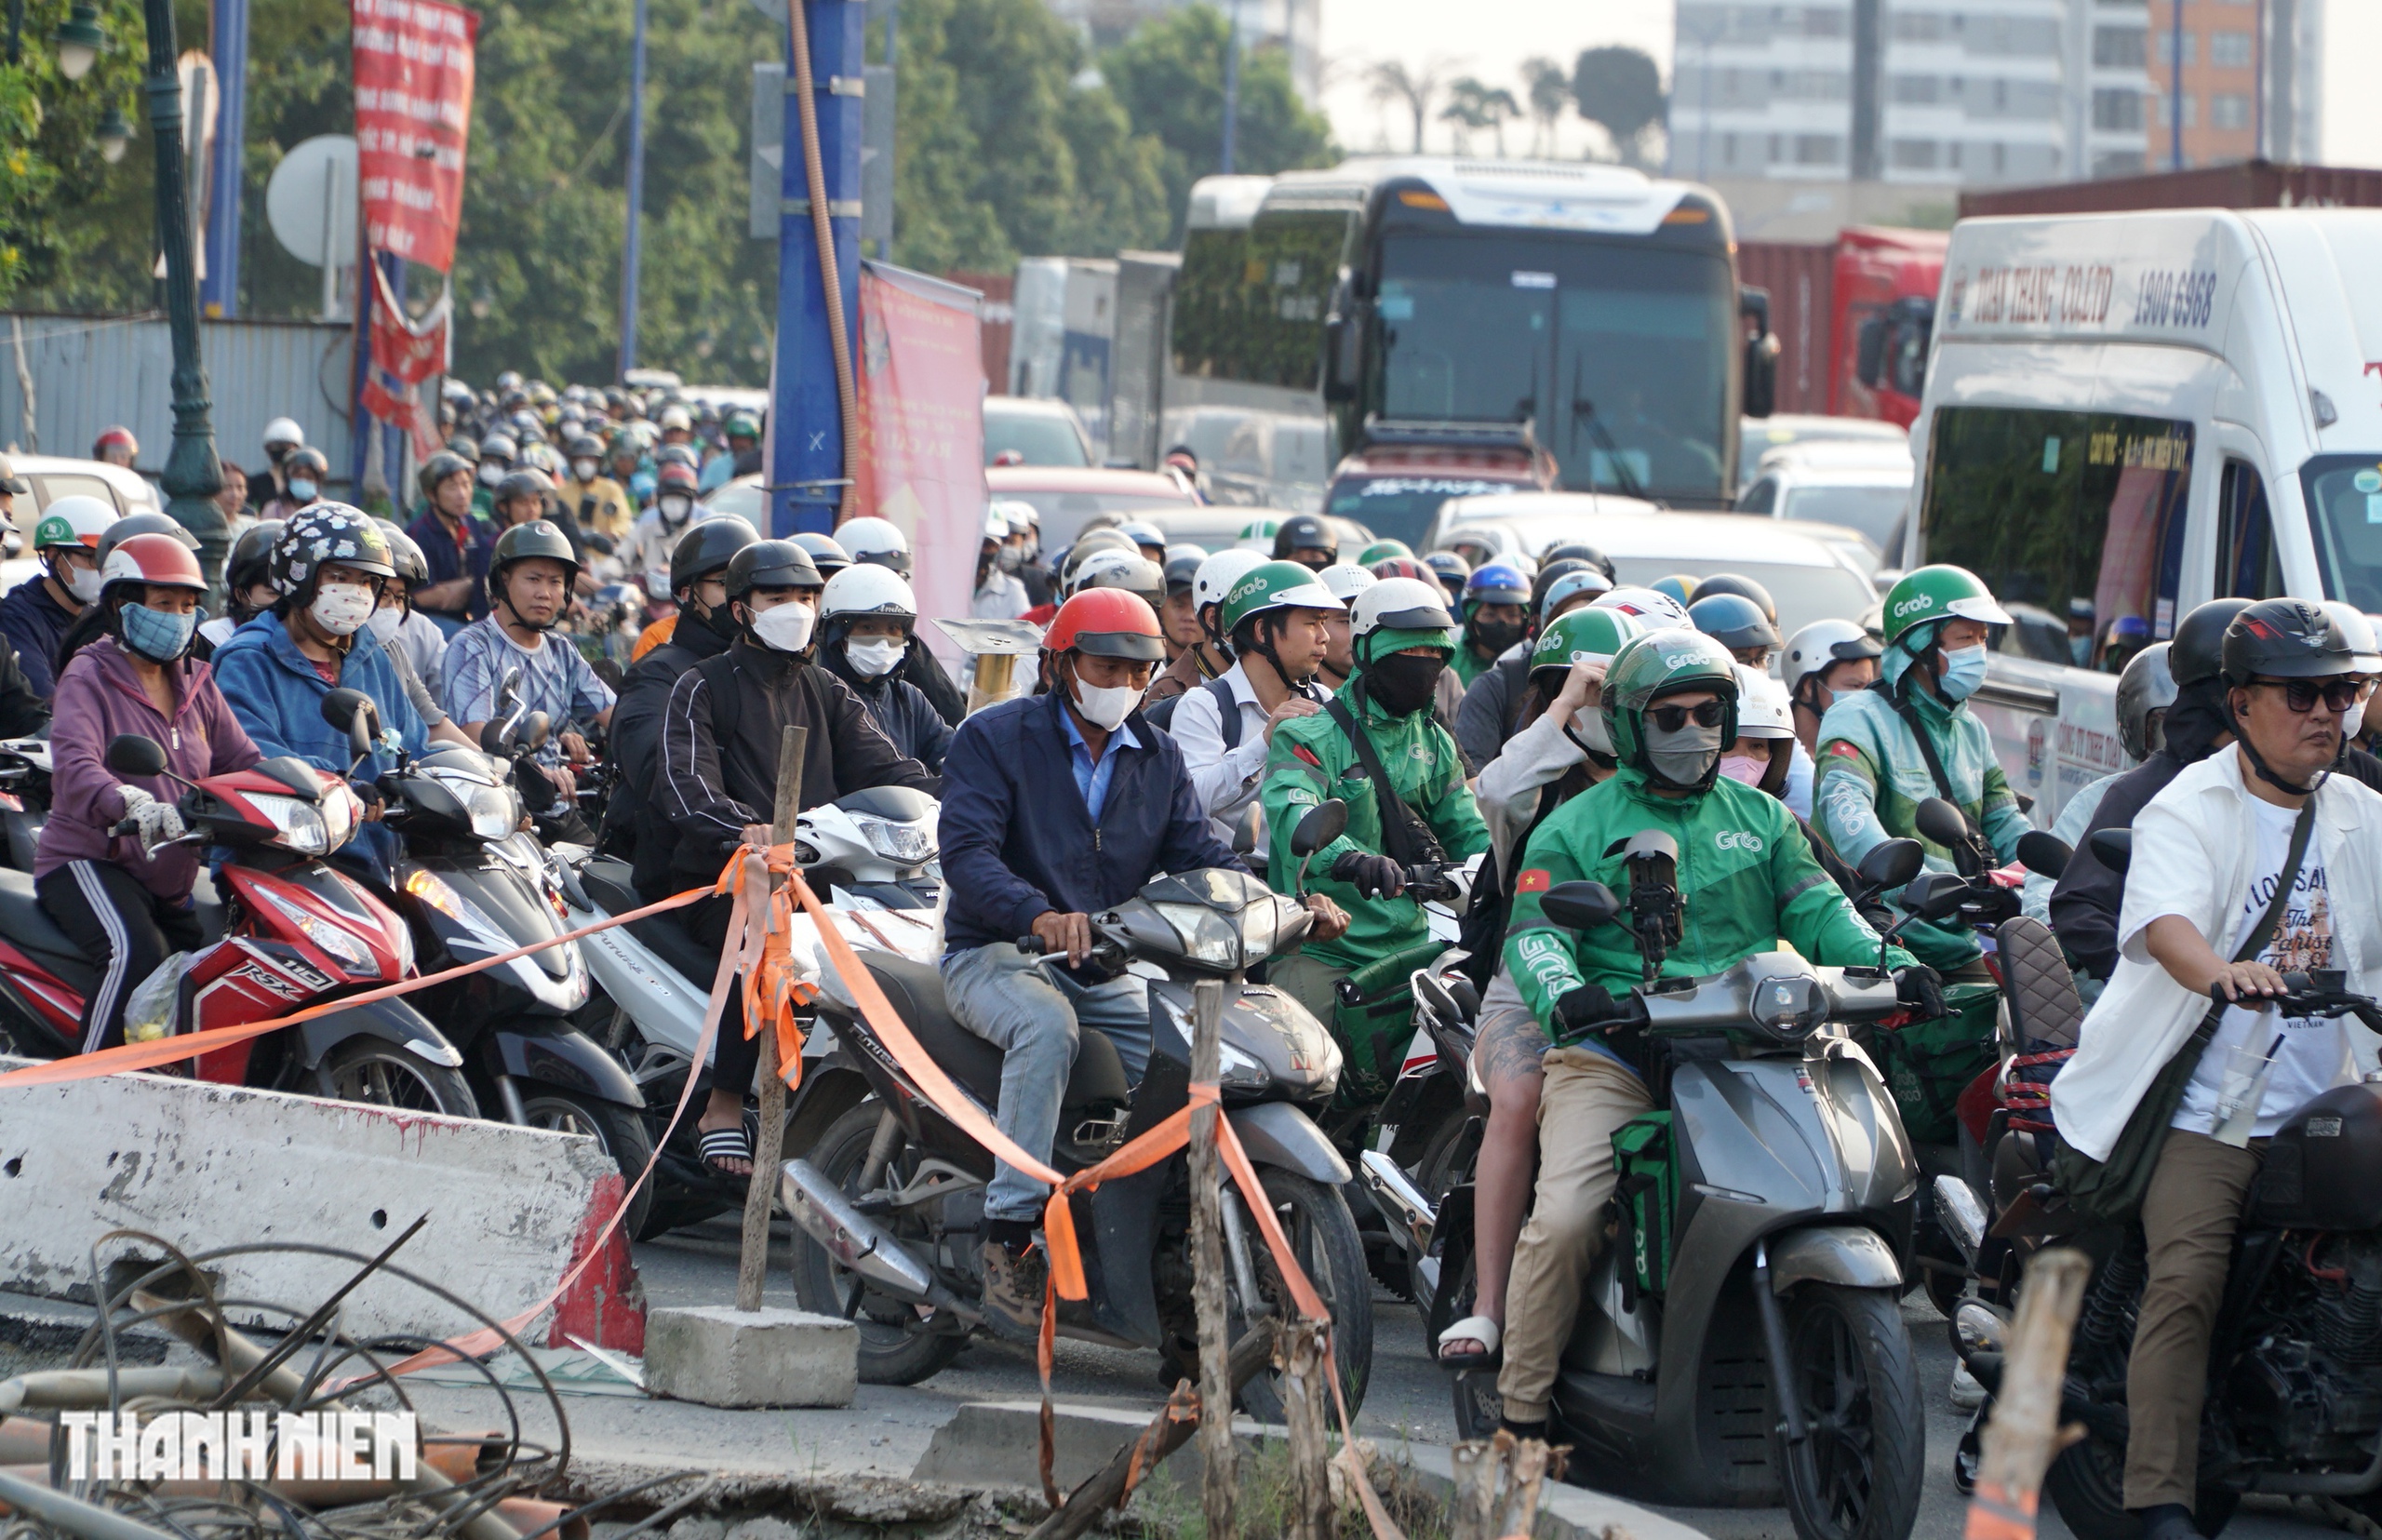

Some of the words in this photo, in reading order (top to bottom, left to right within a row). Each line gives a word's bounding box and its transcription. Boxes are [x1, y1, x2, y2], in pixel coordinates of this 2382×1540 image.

[1229, 576, 1268, 605] Grab
[1894, 593, 1934, 618] Grab
[1666, 649, 1710, 670] Grab
[1715, 830, 1763, 852] Grab
[2285, 908, 2317, 929] The
[224, 959, 305, 1002] RSX
[2286, 1021, 2324, 1029] VIETNAM
